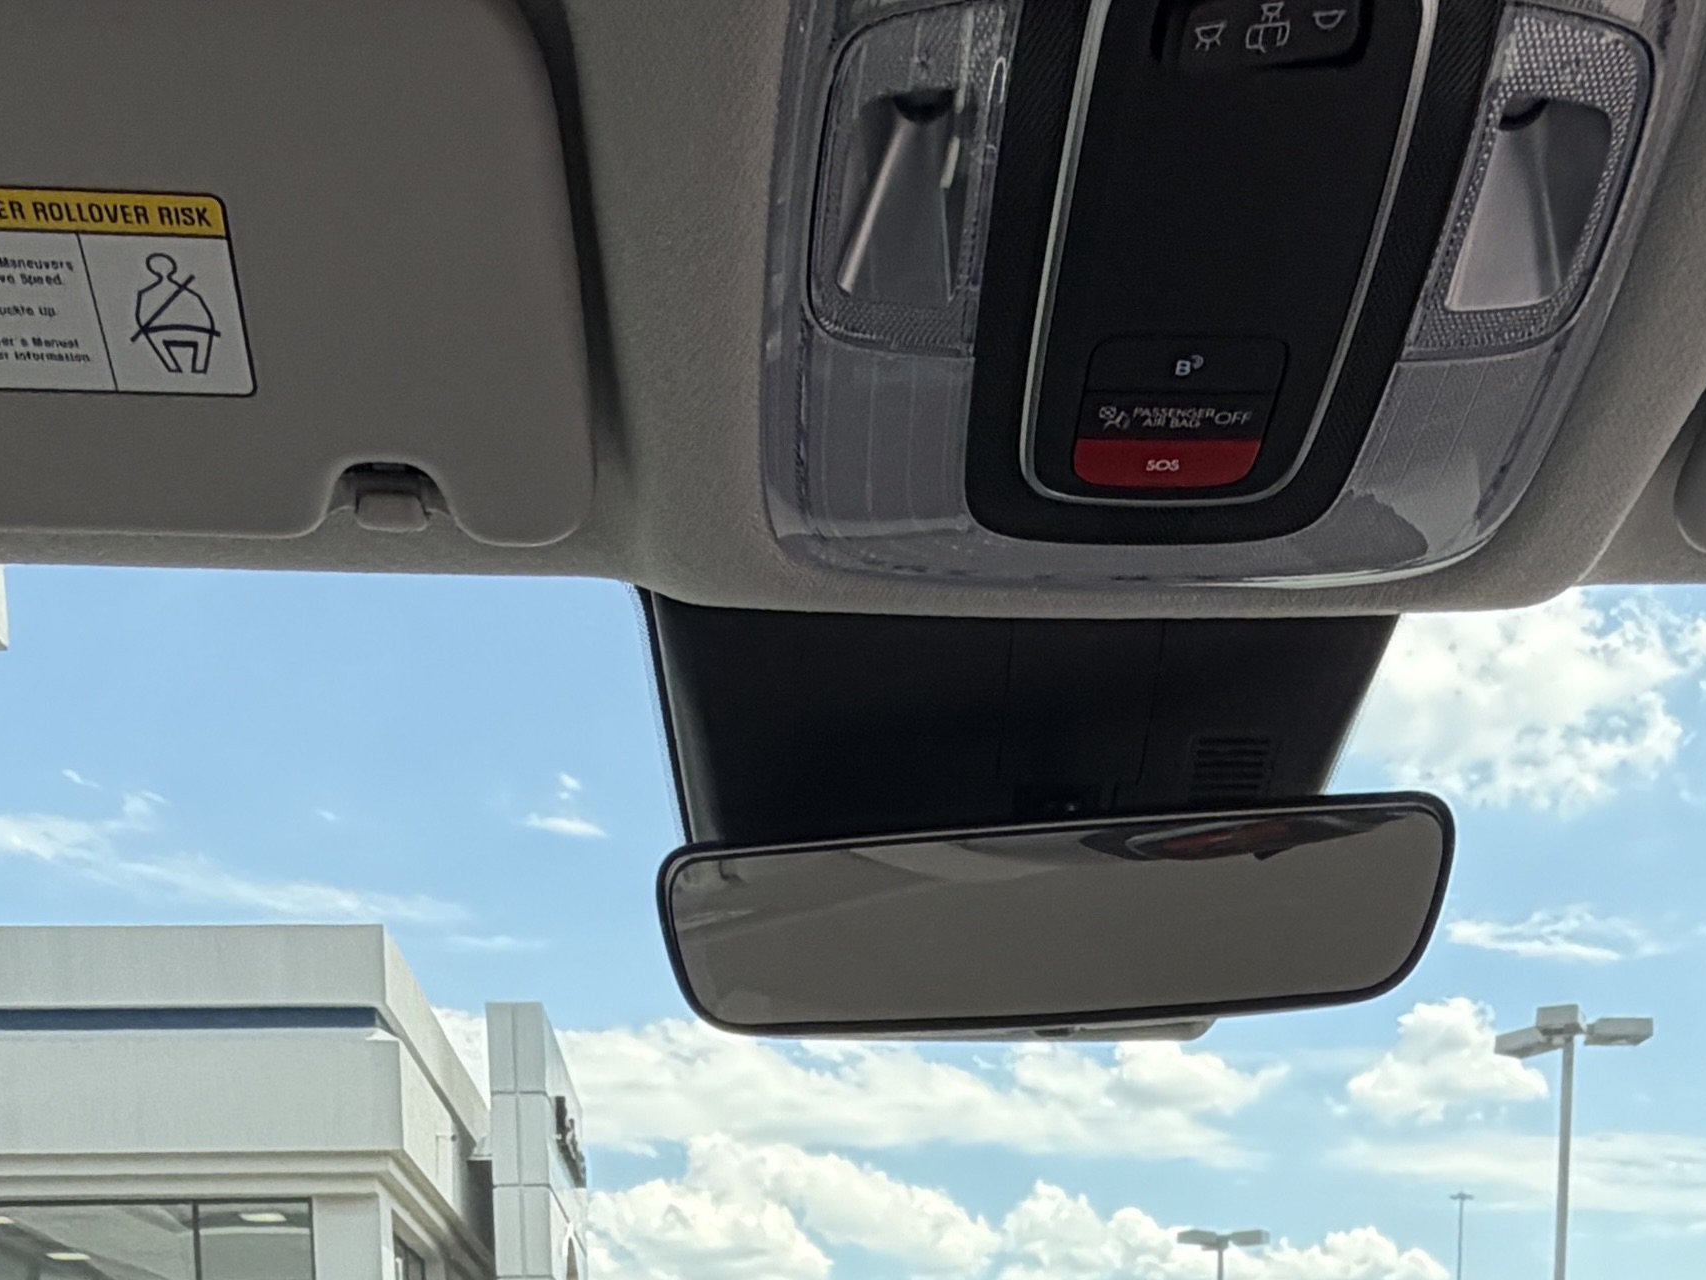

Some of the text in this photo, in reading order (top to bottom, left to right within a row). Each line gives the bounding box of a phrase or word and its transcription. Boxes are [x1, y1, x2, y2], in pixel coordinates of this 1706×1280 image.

[35, 202, 149, 225] ROLLOVER
[161, 206, 212, 227] RISK
[1132, 406, 1215, 419] PASSENGER
[1214, 411, 1253, 425] OFF
[1142, 418, 1201, 429] AIR BAG
[1145, 458, 1180, 471] SOS
